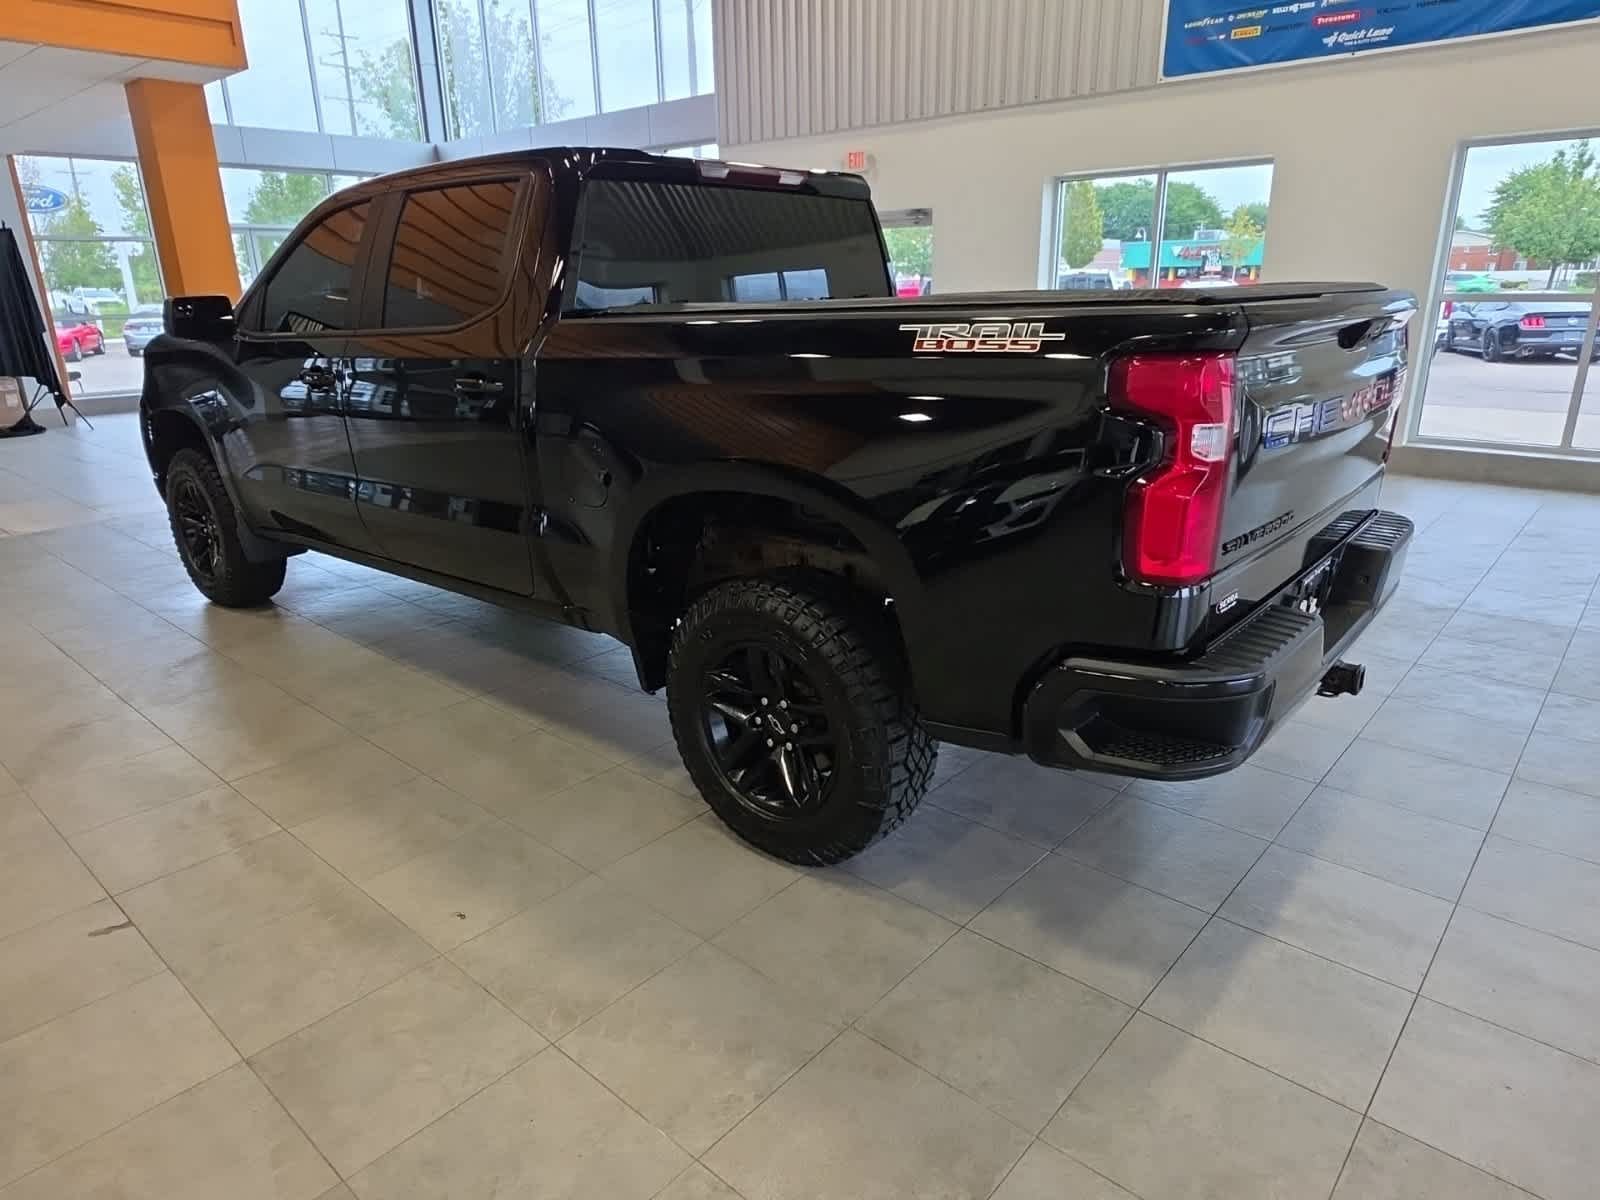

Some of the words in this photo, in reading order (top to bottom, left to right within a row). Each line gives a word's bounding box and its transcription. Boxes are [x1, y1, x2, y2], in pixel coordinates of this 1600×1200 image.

[1338, 30, 1366, 43] Quick
[1367, 26, 1395, 38] Lane
[848, 151, 864, 169] EXIT
[898, 322, 1066, 341] TRAIL
[912, 337, 1042, 353] BOSS
